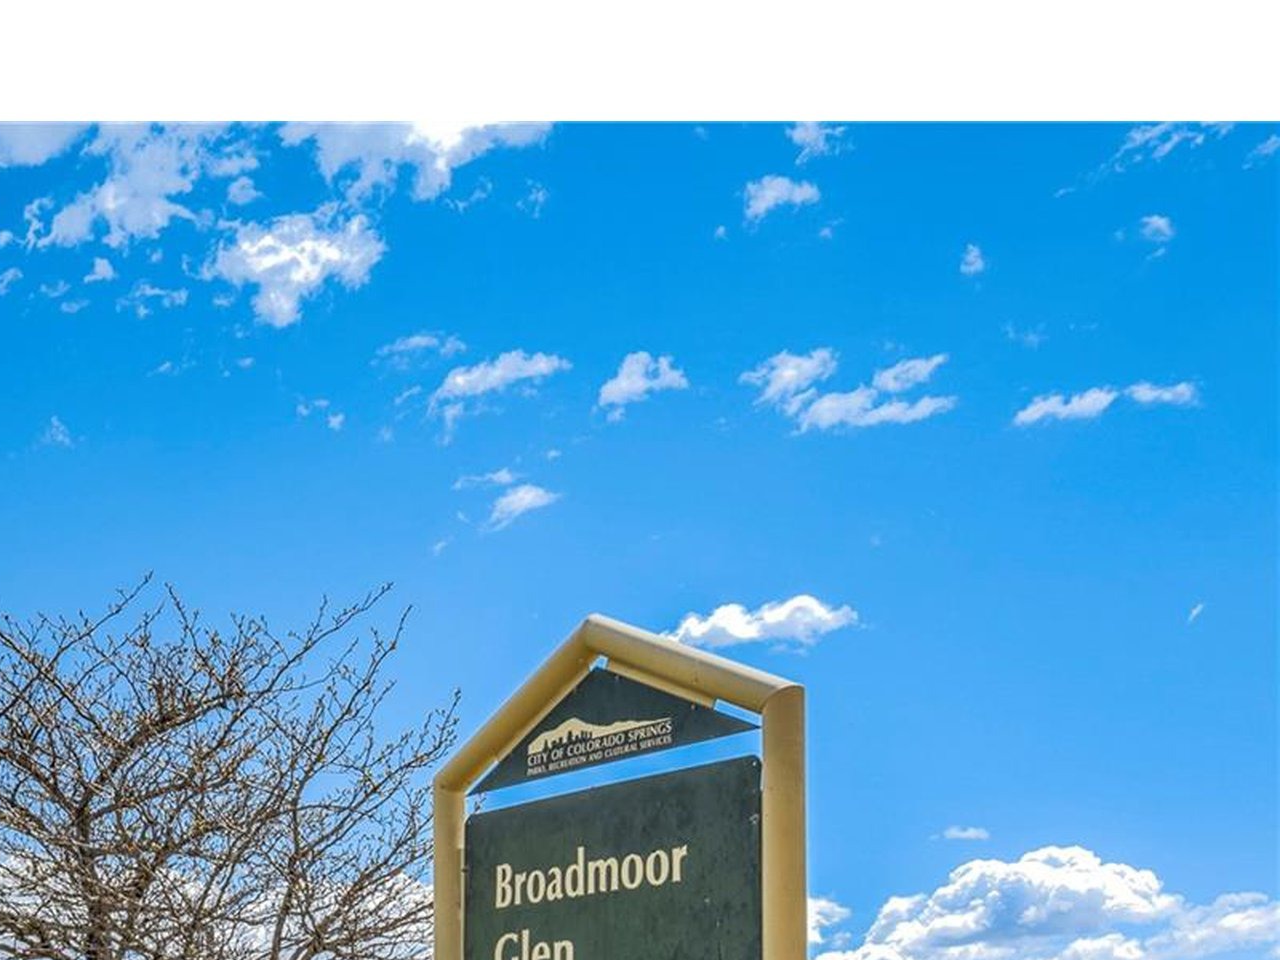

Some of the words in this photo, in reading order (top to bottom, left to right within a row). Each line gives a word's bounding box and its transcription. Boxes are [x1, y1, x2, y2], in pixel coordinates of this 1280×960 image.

[528, 751, 550, 766] CITY
[551, 747, 565, 761] OF
[567, 733, 625, 757] COLORADO
[628, 720, 672, 742] SPRINGS
[495, 845, 688, 909] Broadmoor
